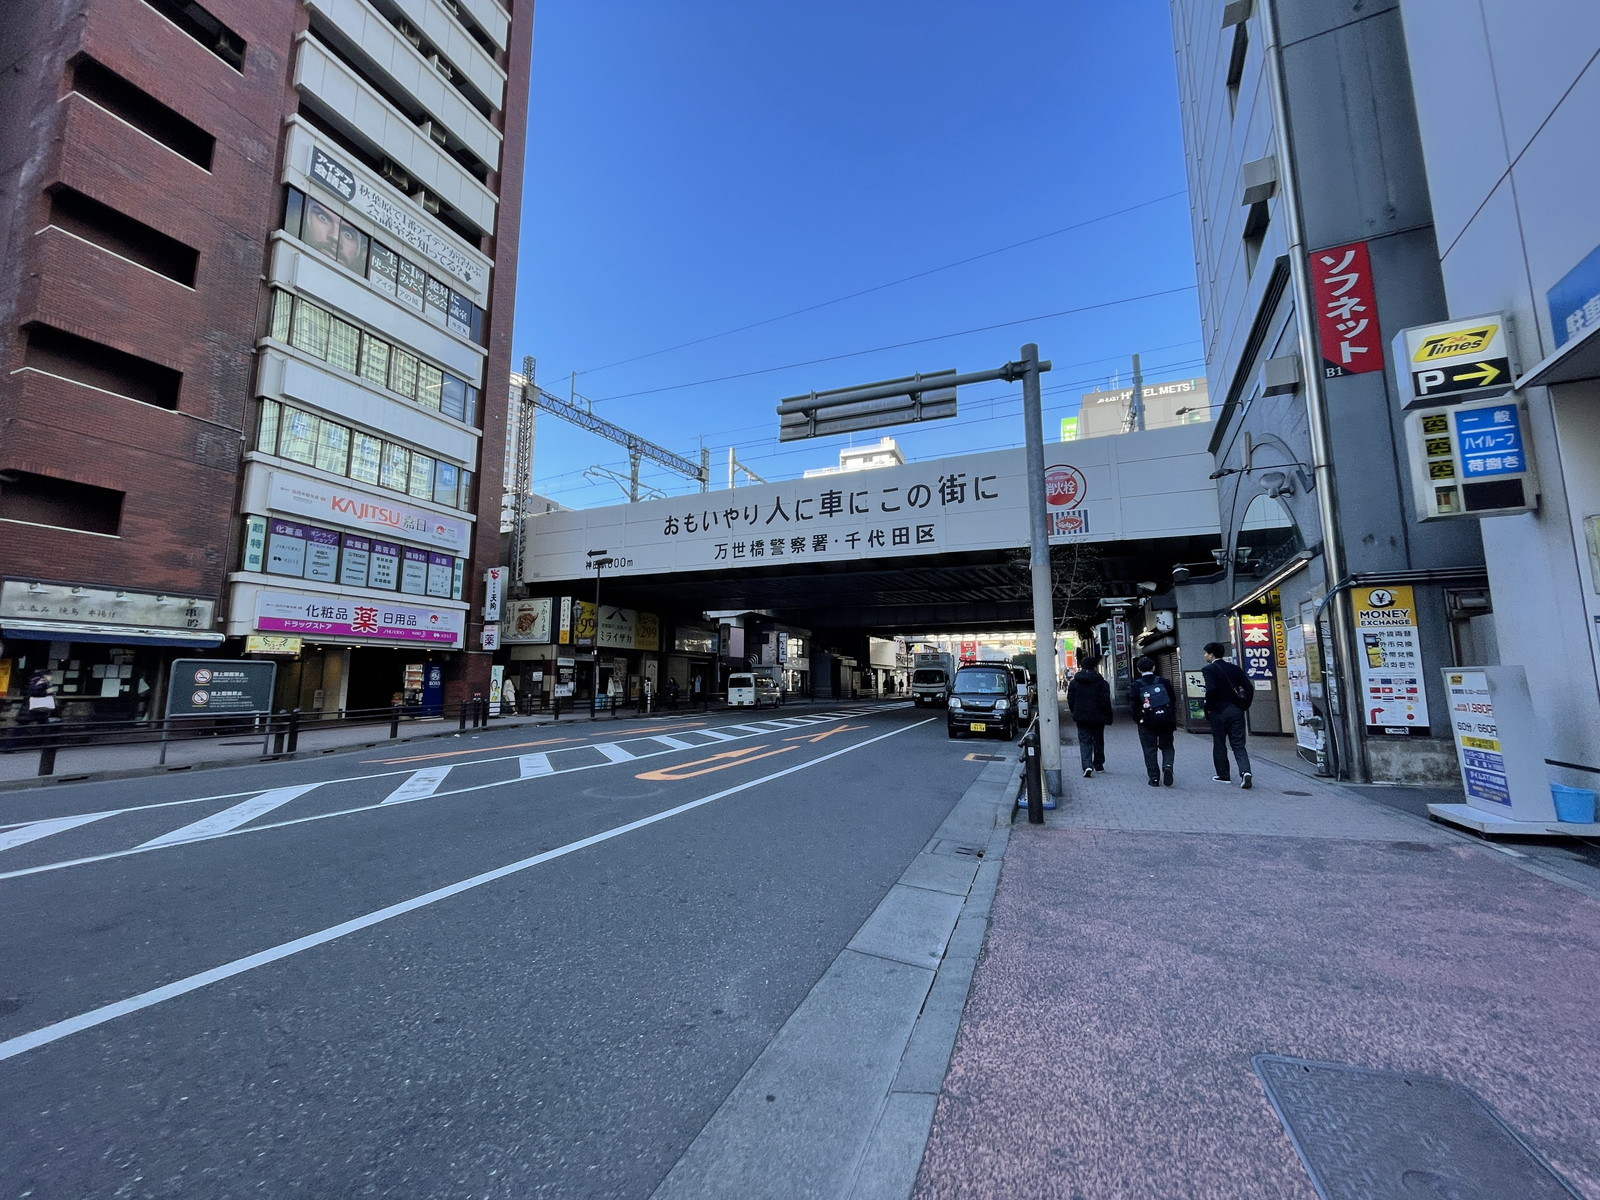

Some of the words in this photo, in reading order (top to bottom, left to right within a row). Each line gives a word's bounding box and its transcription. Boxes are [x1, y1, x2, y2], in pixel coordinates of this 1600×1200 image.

[317, 152, 354, 185] アイデア
[314, 162, 352, 200] 会議室
[1320, 249, 1369, 364] ソフネット
[1423, 335, 1486, 357] Times
[1326, 366, 1343, 377] B1
[1159, 382, 1191, 395] METS
[1418, 372, 1445, 395] P
[1465, 433, 1514, 450] ハイルーフ
[1467, 455, 1519, 472] 荷捌き
[331, 495, 401, 526] KAJITSU
[275, 524, 303, 537] 化粧品
[310, 530, 337, 540] オンライン
[248, 523, 264, 565] 超特価
[313, 536, 334, 545] ショップ
[714, 522, 935, 561] 万世橋警察署・千代田区
[305, 604, 348, 621] 化粧品
[351, 606, 379, 634] 薬
[383, 612, 418, 627] 日用品
[1360, 609, 1409, 620] MONEY
[284, 620, 333, 630] ドラッグストア
[1361, 619, 1411, 627] EXCHANGE
[485, 634, 495, 647] 薬
[600, 630, 632, 644] ミライザカ
[1244, 627, 1269, 644] 本
[1245, 648, 1270, 658] DVD
[1250, 658, 1268, 668] CD
[1247, 668, 1273, 677] ゲーム
